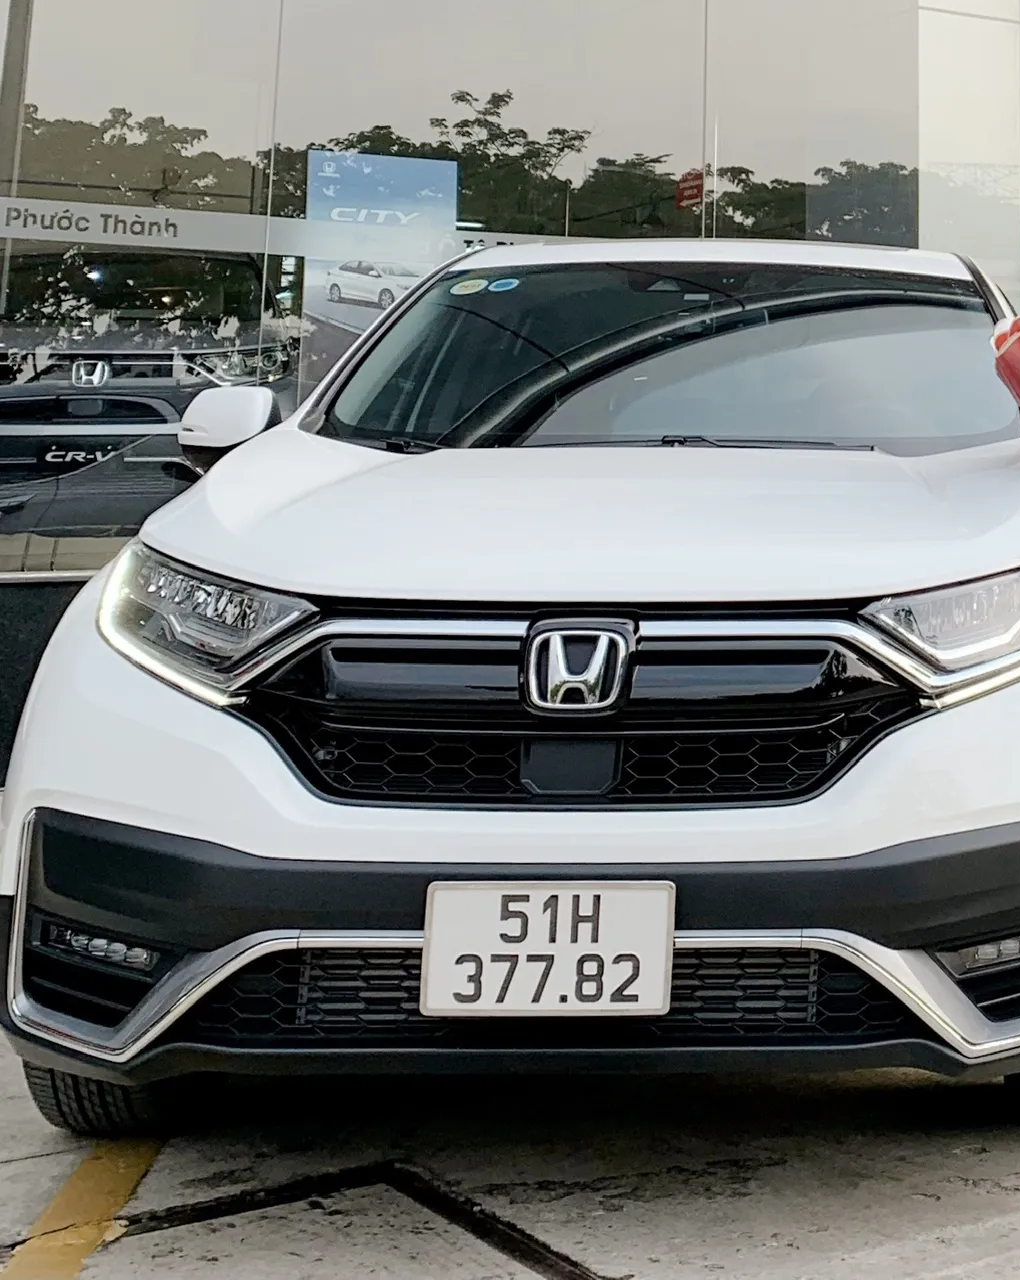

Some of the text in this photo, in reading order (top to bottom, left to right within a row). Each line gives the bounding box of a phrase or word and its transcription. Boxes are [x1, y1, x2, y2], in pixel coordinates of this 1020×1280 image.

[5, 207, 179, 238] Phước Thành
[330, 207, 421, 225] CITY
[45, 448, 117, 463] CR-V
[499, 894, 601, 944] 51H
[452, 953, 641, 1004] 377.82
